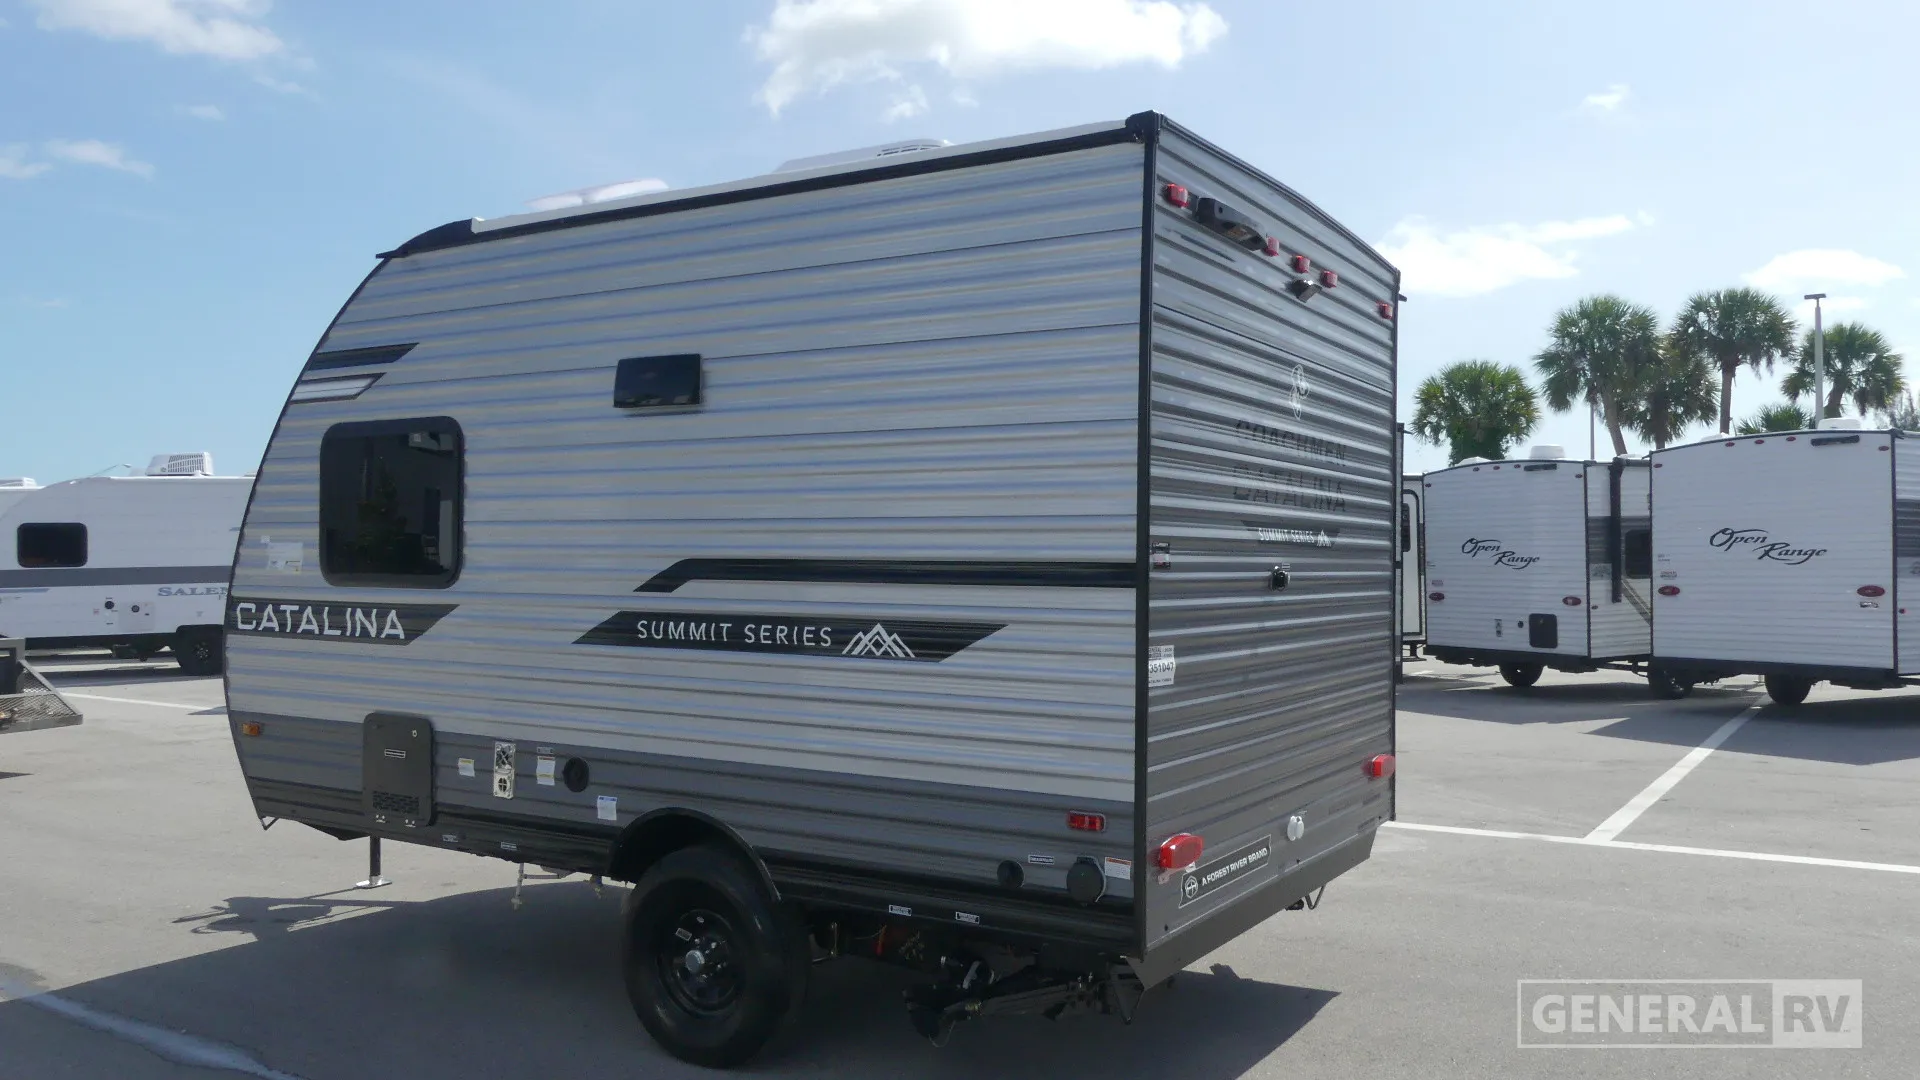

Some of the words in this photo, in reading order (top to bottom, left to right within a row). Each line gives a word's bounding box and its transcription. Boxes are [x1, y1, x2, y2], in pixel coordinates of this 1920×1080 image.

[1258, 528, 1289, 542] SUMMIT
[1291, 529, 1314, 543] SERIES
[1709, 527, 1769, 552] Open
[1752, 542, 1827, 565] Range
[1461, 538, 1503, 557] Open
[1489, 550, 1540, 569] Range
[236, 602, 405, 639] CATALINA
[637, 620, 732, 642] SUMMIT
[744, 623, 831, 647] SERIES
[1201, 877, 1208, 886] A
[1206, 864, 1230, 883] FOREST
[1230, 857, 1248, 872] RIVER
[1248, 847, 1268, 863] BRAND
